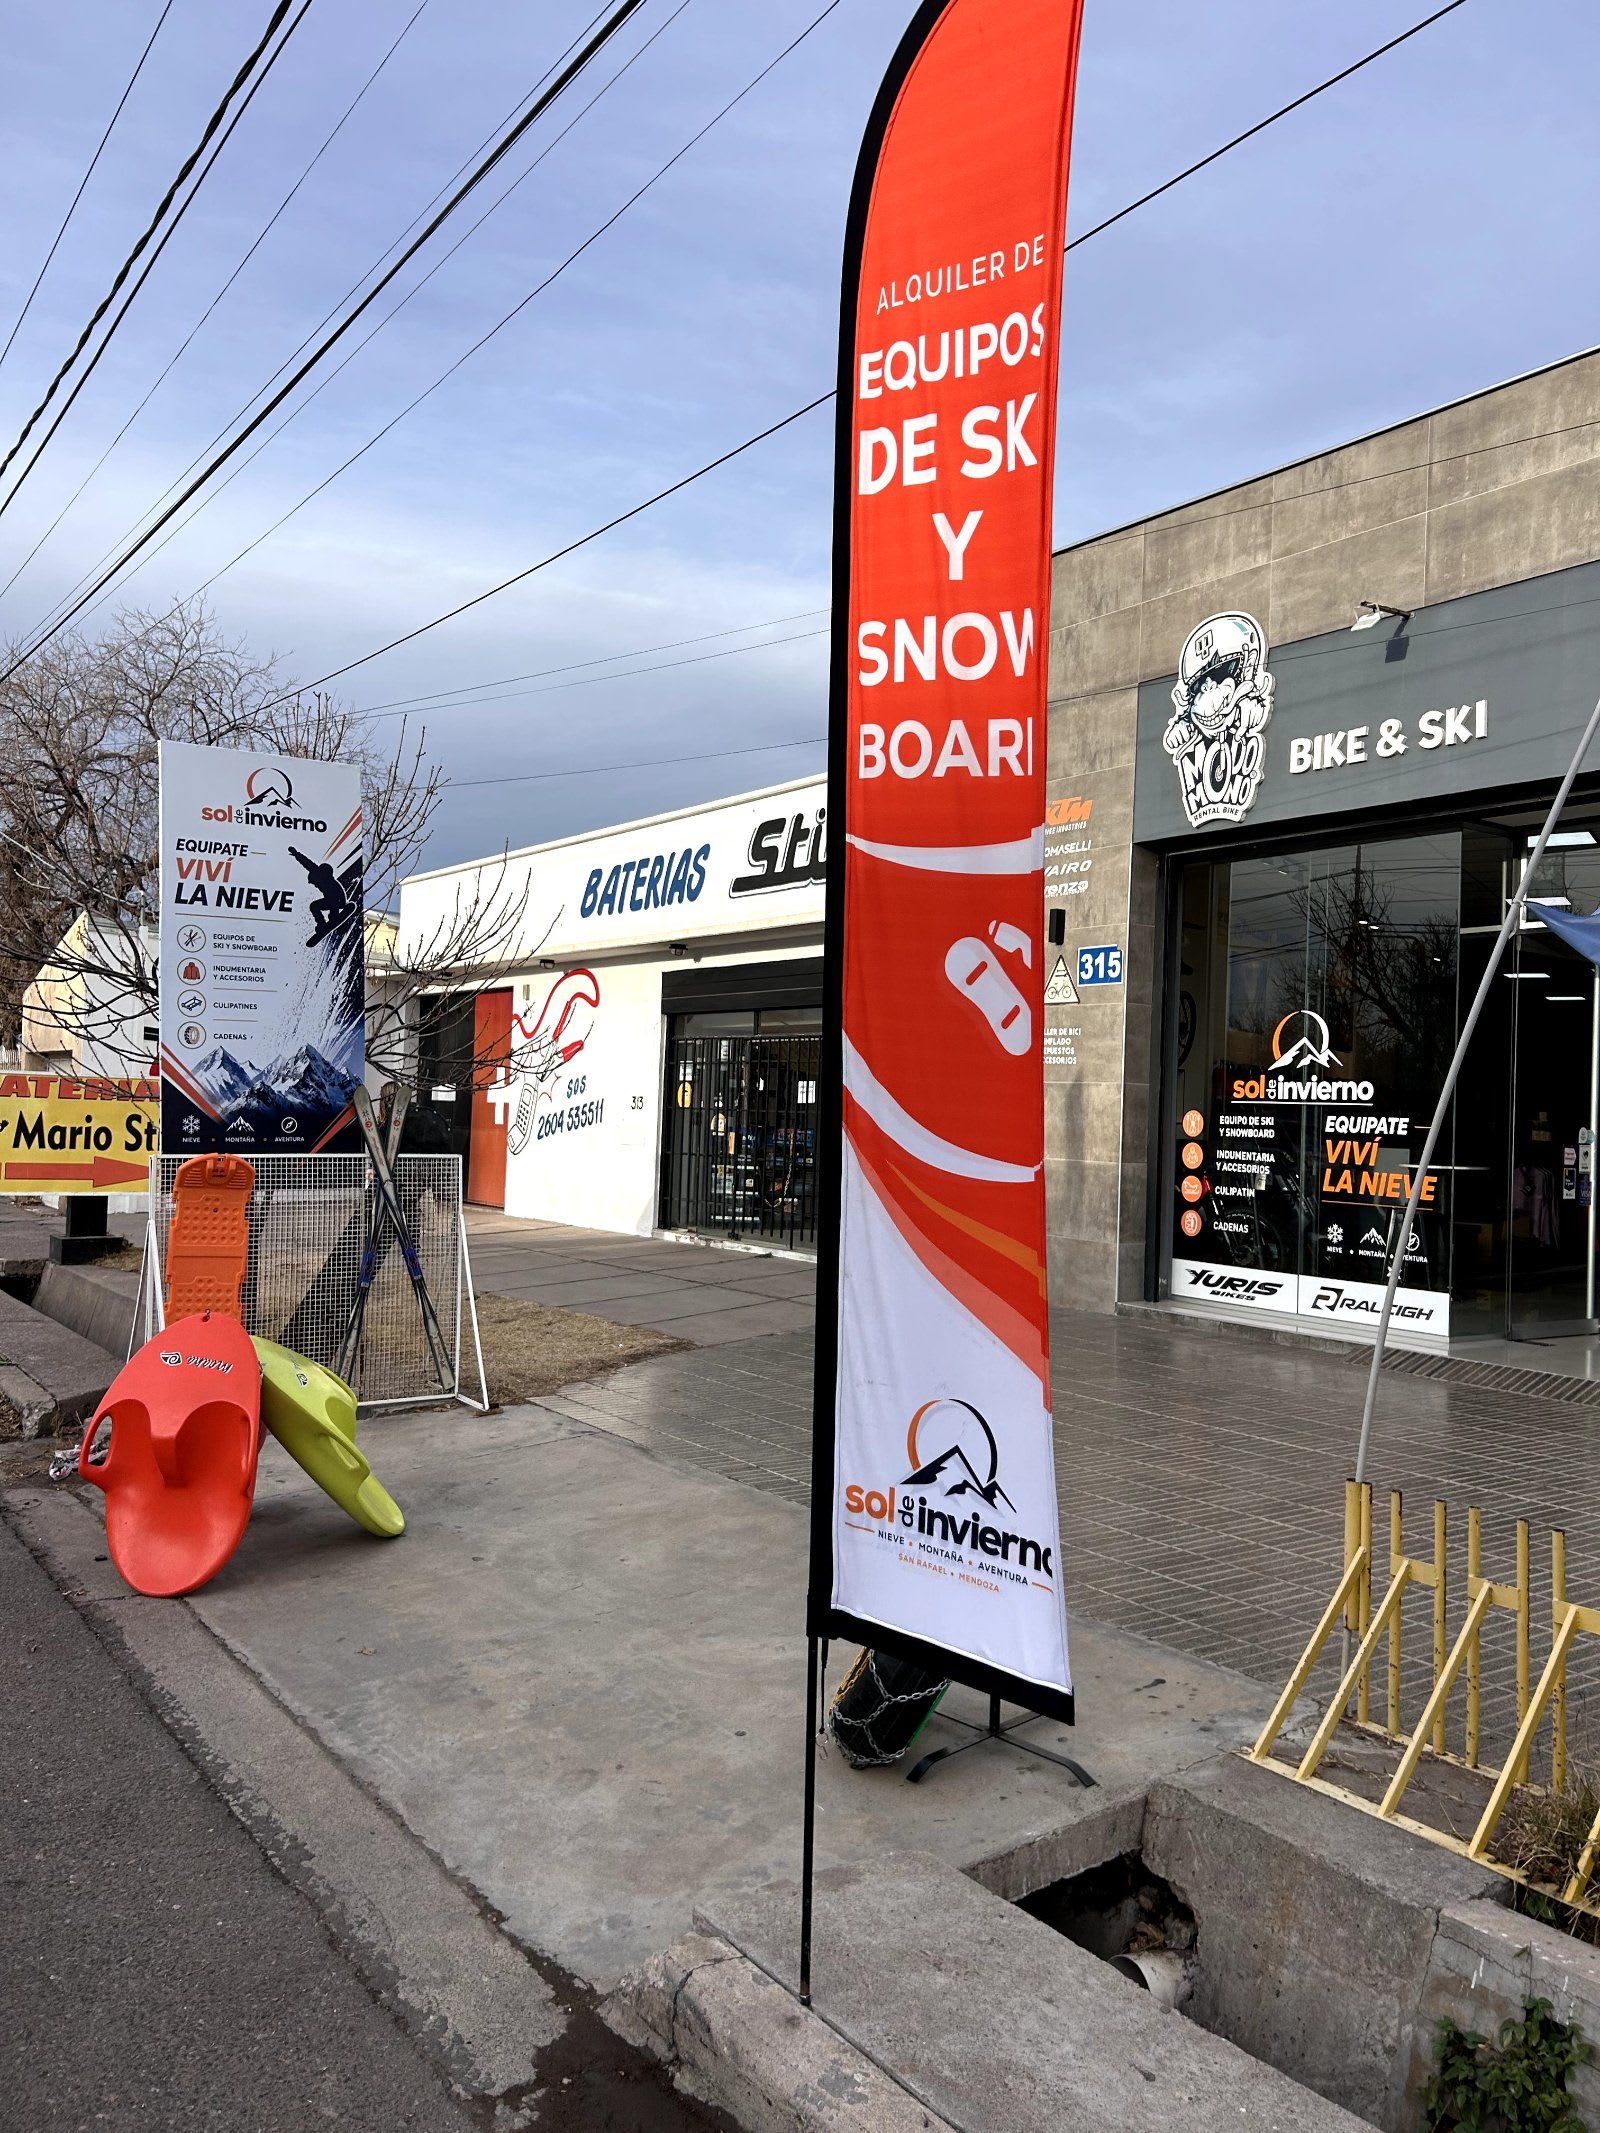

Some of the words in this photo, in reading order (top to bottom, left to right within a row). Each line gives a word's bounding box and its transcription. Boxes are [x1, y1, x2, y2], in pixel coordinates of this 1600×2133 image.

[876, 250, 1005, 315] ALQUILER
[1014, 233, 1045, 273] DE
[859, 302, 1045, 400] EQUIPOS
[858, 413, 938, 495] DE
[960, 392, 1038, 479] SK
[932, 510, 984, 581] Y
[858, 717, 1033, 780] BOAR
[1289, 725, 1370, 774] BIKE
[1375, 718, 1409, 758] &
[1418, 699, 1488, 750] SKI
[201, 805, 233, 823] sol
[234, 809, 244, 824] de
[245, 807, 328, 833] invierno
[1193, 807, 1221, 822] RENTAL
[1222, 806, 1240, 816] BIKE
[175, 838, 249, 857] EQUIPATE
[1044, 839, 1092, 858] OMASELLI
[176, 857, 234, 883] VIVÍ
[580, 843, 711, 918] BATERIAS
[174, 882, 208, 907] LA
[215, 885, 295, 912] NIEVE
[213, 933, 245, 942] EQUIPOS
[213, 942, 224, 950] SKI
[232, 943, 278, 952] SNOWBOARD
[213, 965, 266, 974] INDUMENTARIA
[1080, 951, 1121, 980] 315
[219, 974, 265, 983] ACCESORIOS
[213, 1002, 258, 1010] CULIPATINES
[213, 1032, 248, 1040] CADENAS
[1044, 1047, 1077, 1055] EPUESTOS
[566, 1075, 587, 1099] SOS
[1233, 1074, 1266, 1099] sol
[1266, 1079, 1277, 1099] de
[1277, 1074, 1375, 1101] invierno
[12, 1110, 113, 1151] Mario
[1219, 1115, 1248, 1126] EQUIPO
[1249, 1116, 1260, 1126] DE
[1261, 1116, 1275, 1126] SKI
[1325, 1115, 1410, 1136] EQUIPATE
[1219, 1128, 1225, 1137] Y
[1225, 1128, 1275, 1138] SNOWBOARD
[1216, 1149, 1276, 1163] INDUMENTARIA
[1325, 1136, 1383, 1167] VIVÍ
[1216, 1162, 1222, 1171] Y
[1222, 1162, 1270, 1174] ACCESORIOS
[1214, 1185, 1255, 1198] CULIPATIN
[1322, 1168, 1353, 1194] LA
[1213, 1221, 1249, 1234] CADENAS
[1326, 1246, 1343, 1254] NIEVE
[1185, 1268, 1284, 1296] YURIS
[1209, 1289, 1257, 1301] BIKES
[845, 1484, 896, 1523] sol
[898, 1495, 915, 1528] de
[878, 1529, 905, 1545] NIEVE
[918, 1542, 964, 1565] MONTAÑA
[977, 1561, 1029, 1586] AVENTURA
[898, 1553, 916, 1566] SAN
[916, 1556, 948, 1576] RAFAEL
[958, 1572, 1000, 1593] MENDOZA
